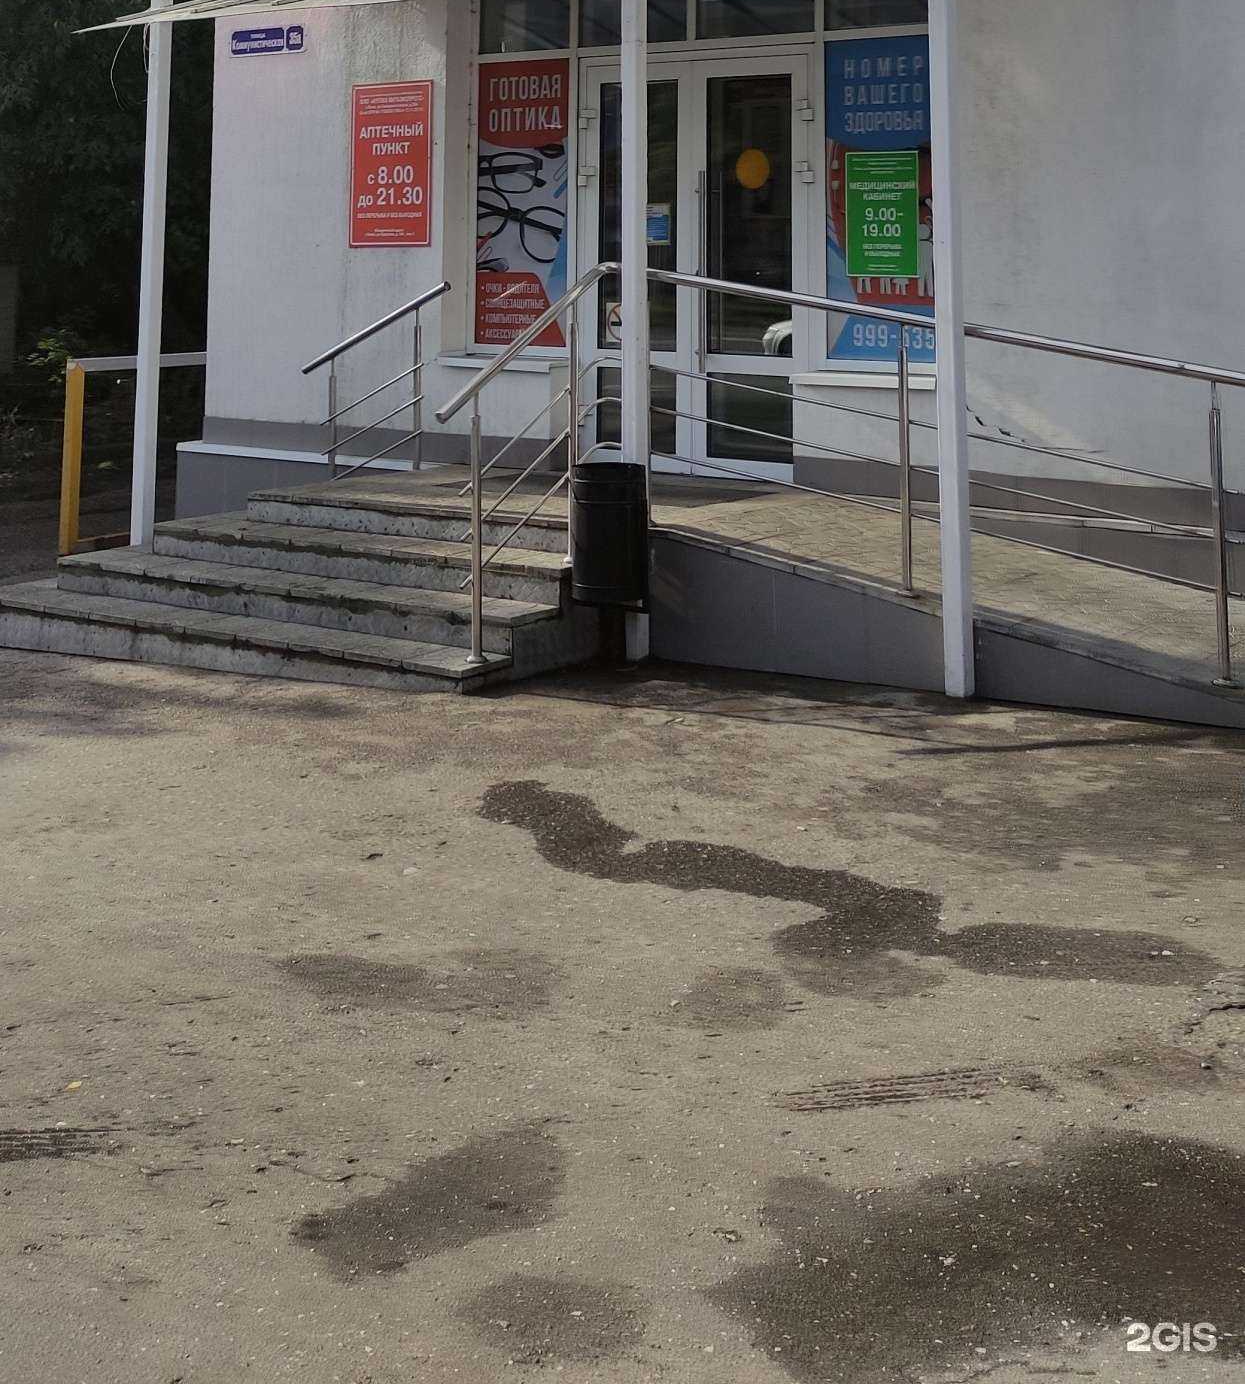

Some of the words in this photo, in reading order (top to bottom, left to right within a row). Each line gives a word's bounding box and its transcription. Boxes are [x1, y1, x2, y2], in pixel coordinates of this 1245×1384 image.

[844, 55, 925, 79] НОМЕР
[490, 74, 562, 102] ГОТОВАЯ
[844, 83, 924, 105] ВАШЕГО
[360, 121, 424, 139] АПТЕЧНЫЙ
[489, 105, 563, 133] ОПТИКА
[844, 110, 924, 134] ЗДОРОВЬЯ
[372, 142, 411, 155] ПУНКТ
[367, 174, 375, 185] с
[378, 165, 413, 184] 8.00
[357, 195, 374, 209] до
[376, 186, 423, 205] 21.30
[865, 208, 904, 222] 9.00-
[862, 223, 901, 237] 19.00
